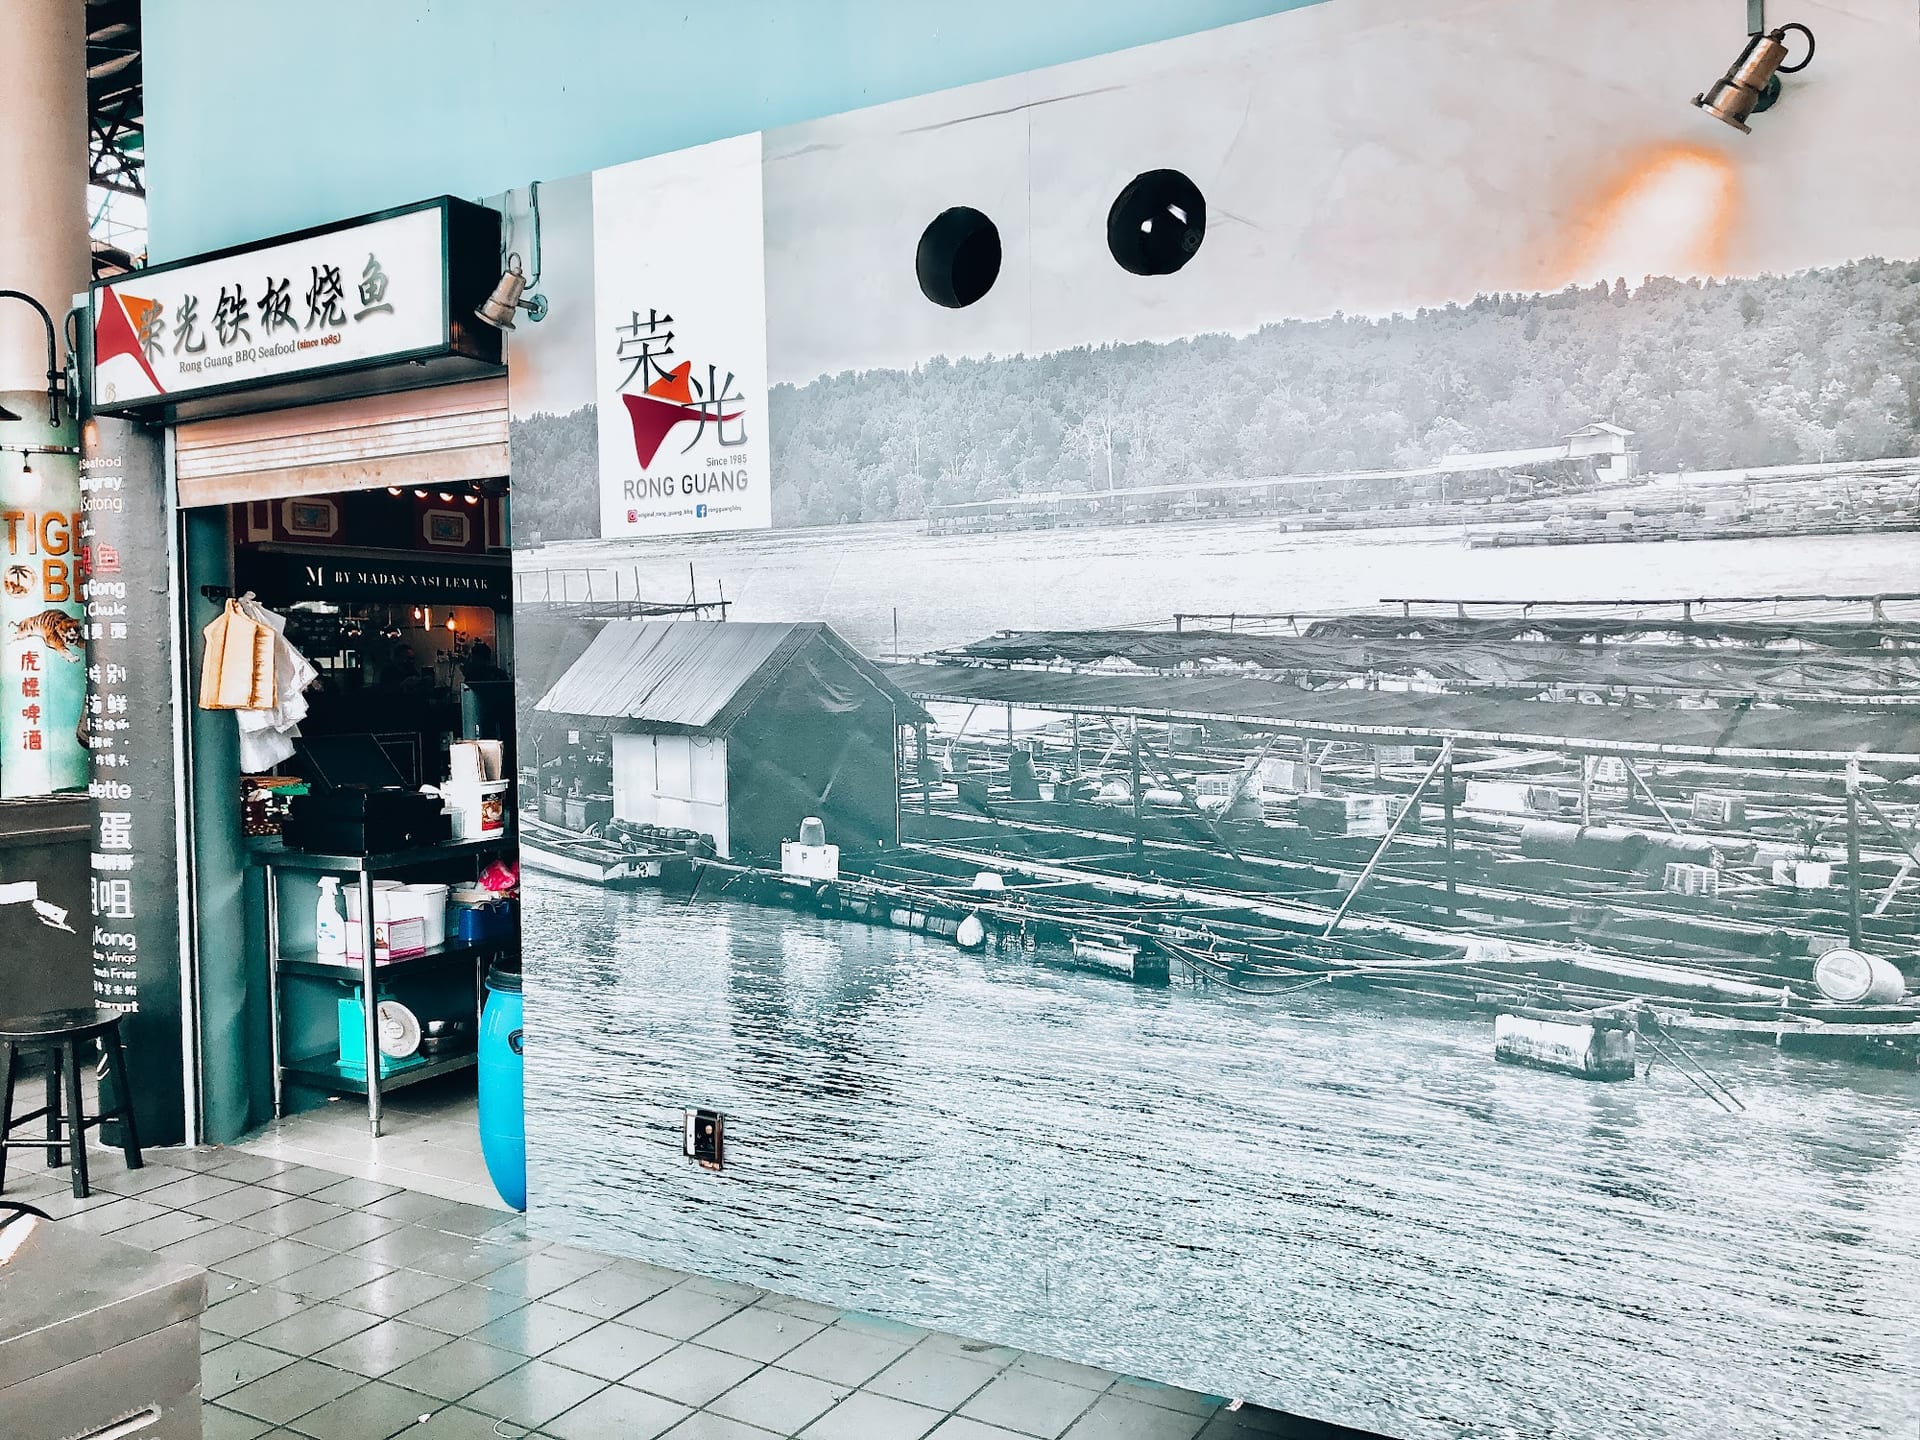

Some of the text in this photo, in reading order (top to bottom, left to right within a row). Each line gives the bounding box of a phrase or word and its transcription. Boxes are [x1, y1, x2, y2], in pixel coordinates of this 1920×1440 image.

[138, 252, 395, 364] 荣光铁板烧鱼
[178, 333, 342, 374] Rong Guang BBQ Seafood (since 1985)
[615, 308, 677, 394] 荣
[681, 364, 748, 455] 光
[82, 456, 122, 469] Seafood
[706, 454, 748, 468] Since 1985
[623, 470, 748, 500] RONG GUANG
[83, 496, 123, 513] Sotong
[88, 579, 126, 599] Gong
[306, 566, 488, 590] M BY MADAS NASI LEMAK
[94, 925, 137, 950] Kong
[105, 951, 137, 965] Wings
[110, 967, 137, 979] Fries
